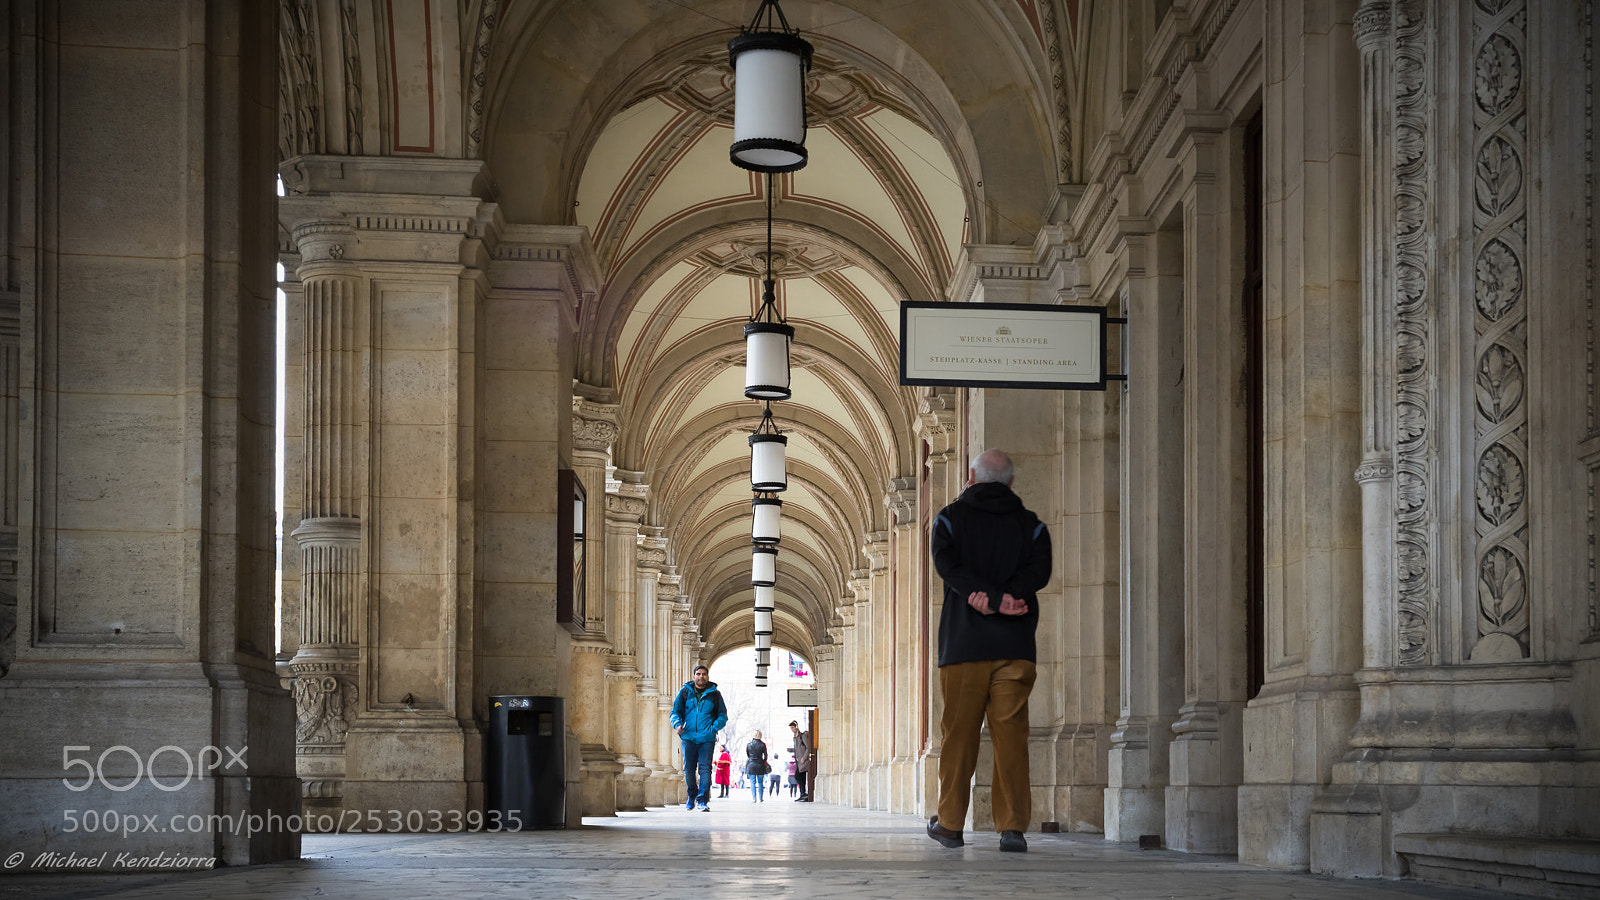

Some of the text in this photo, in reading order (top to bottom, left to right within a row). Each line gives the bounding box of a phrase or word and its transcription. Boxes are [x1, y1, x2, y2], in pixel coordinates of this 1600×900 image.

[959, 335, 1049, 345] WIENER STAATSOPER
[1012, 358, 1054, 366] STANDING
